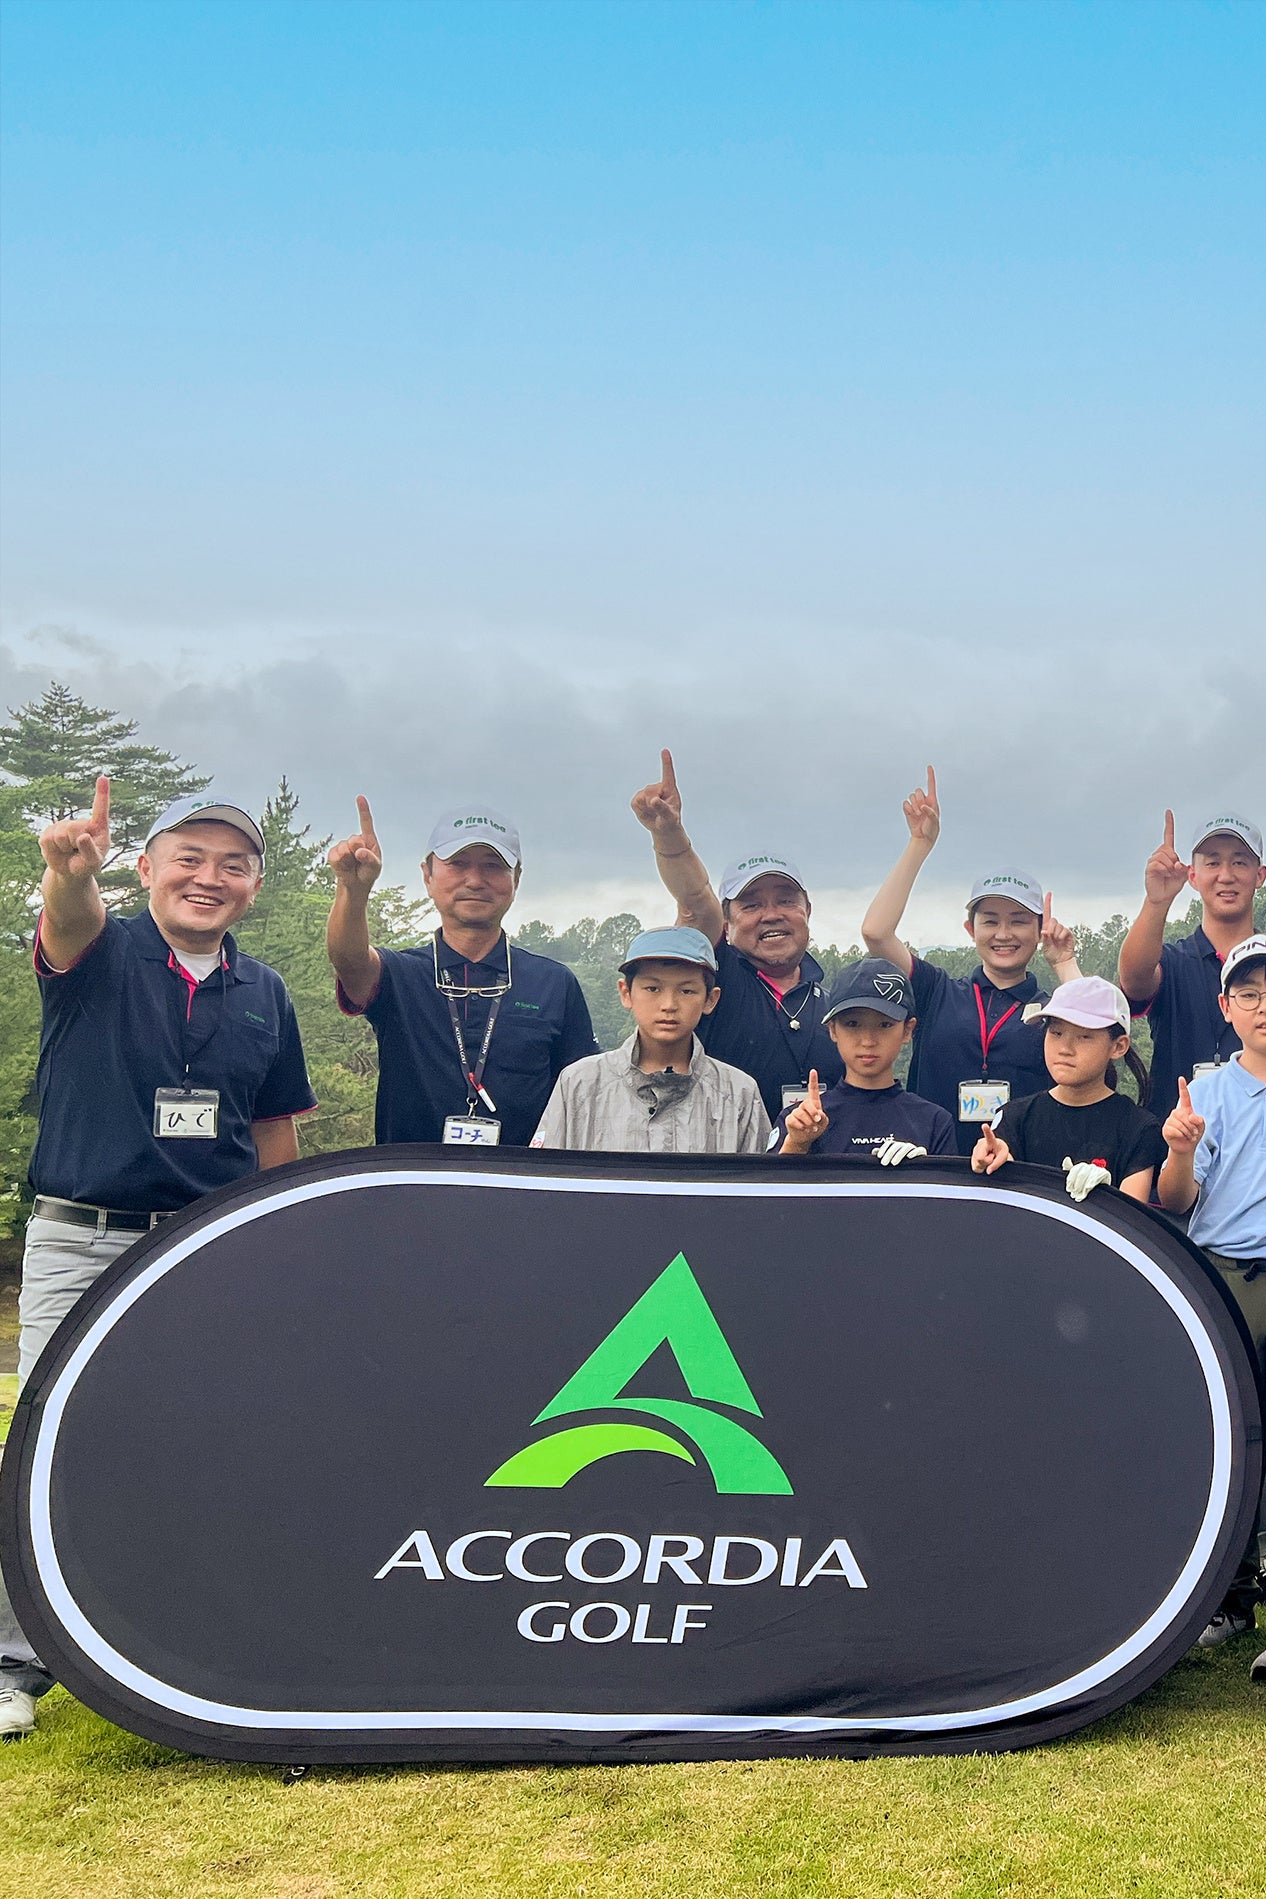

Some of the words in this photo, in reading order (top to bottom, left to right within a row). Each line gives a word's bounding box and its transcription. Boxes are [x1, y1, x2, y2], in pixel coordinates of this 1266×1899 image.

[466, 816, 488, 825] first
[490, 820, 506, 833] tee
[748, 856, 770, 865] first
[770, 857, 787, 867] tee
[992, 876, 1012, 884] first
[1014, 878, 1029, 889] tee
[163, 1107, 213, 1129] ひで
[451, 1126, 483, 1143] コーチ
[373, 1530, 868, 1589] ACCORDIA
[516, 1600, 713, 1645] GOLF
